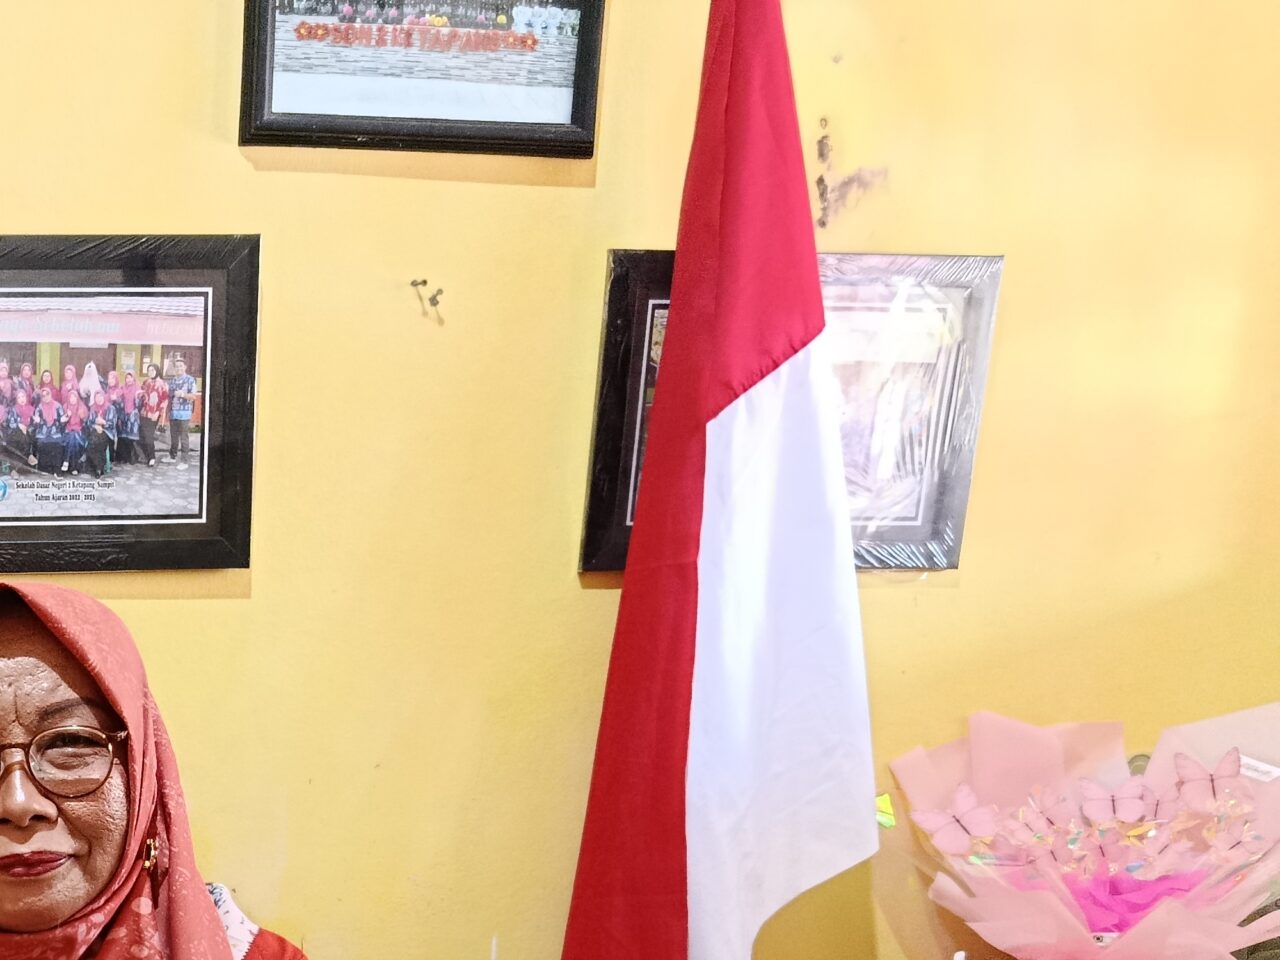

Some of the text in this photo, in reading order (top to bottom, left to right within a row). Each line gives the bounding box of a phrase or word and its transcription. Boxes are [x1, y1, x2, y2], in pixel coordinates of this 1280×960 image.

[15, 481, 35, 489] Sekolah
[36, 481, 50, 489] Dasar
[35, 493, 50, 501] Tahun
[52, 493, 68, 501] Ajaran
